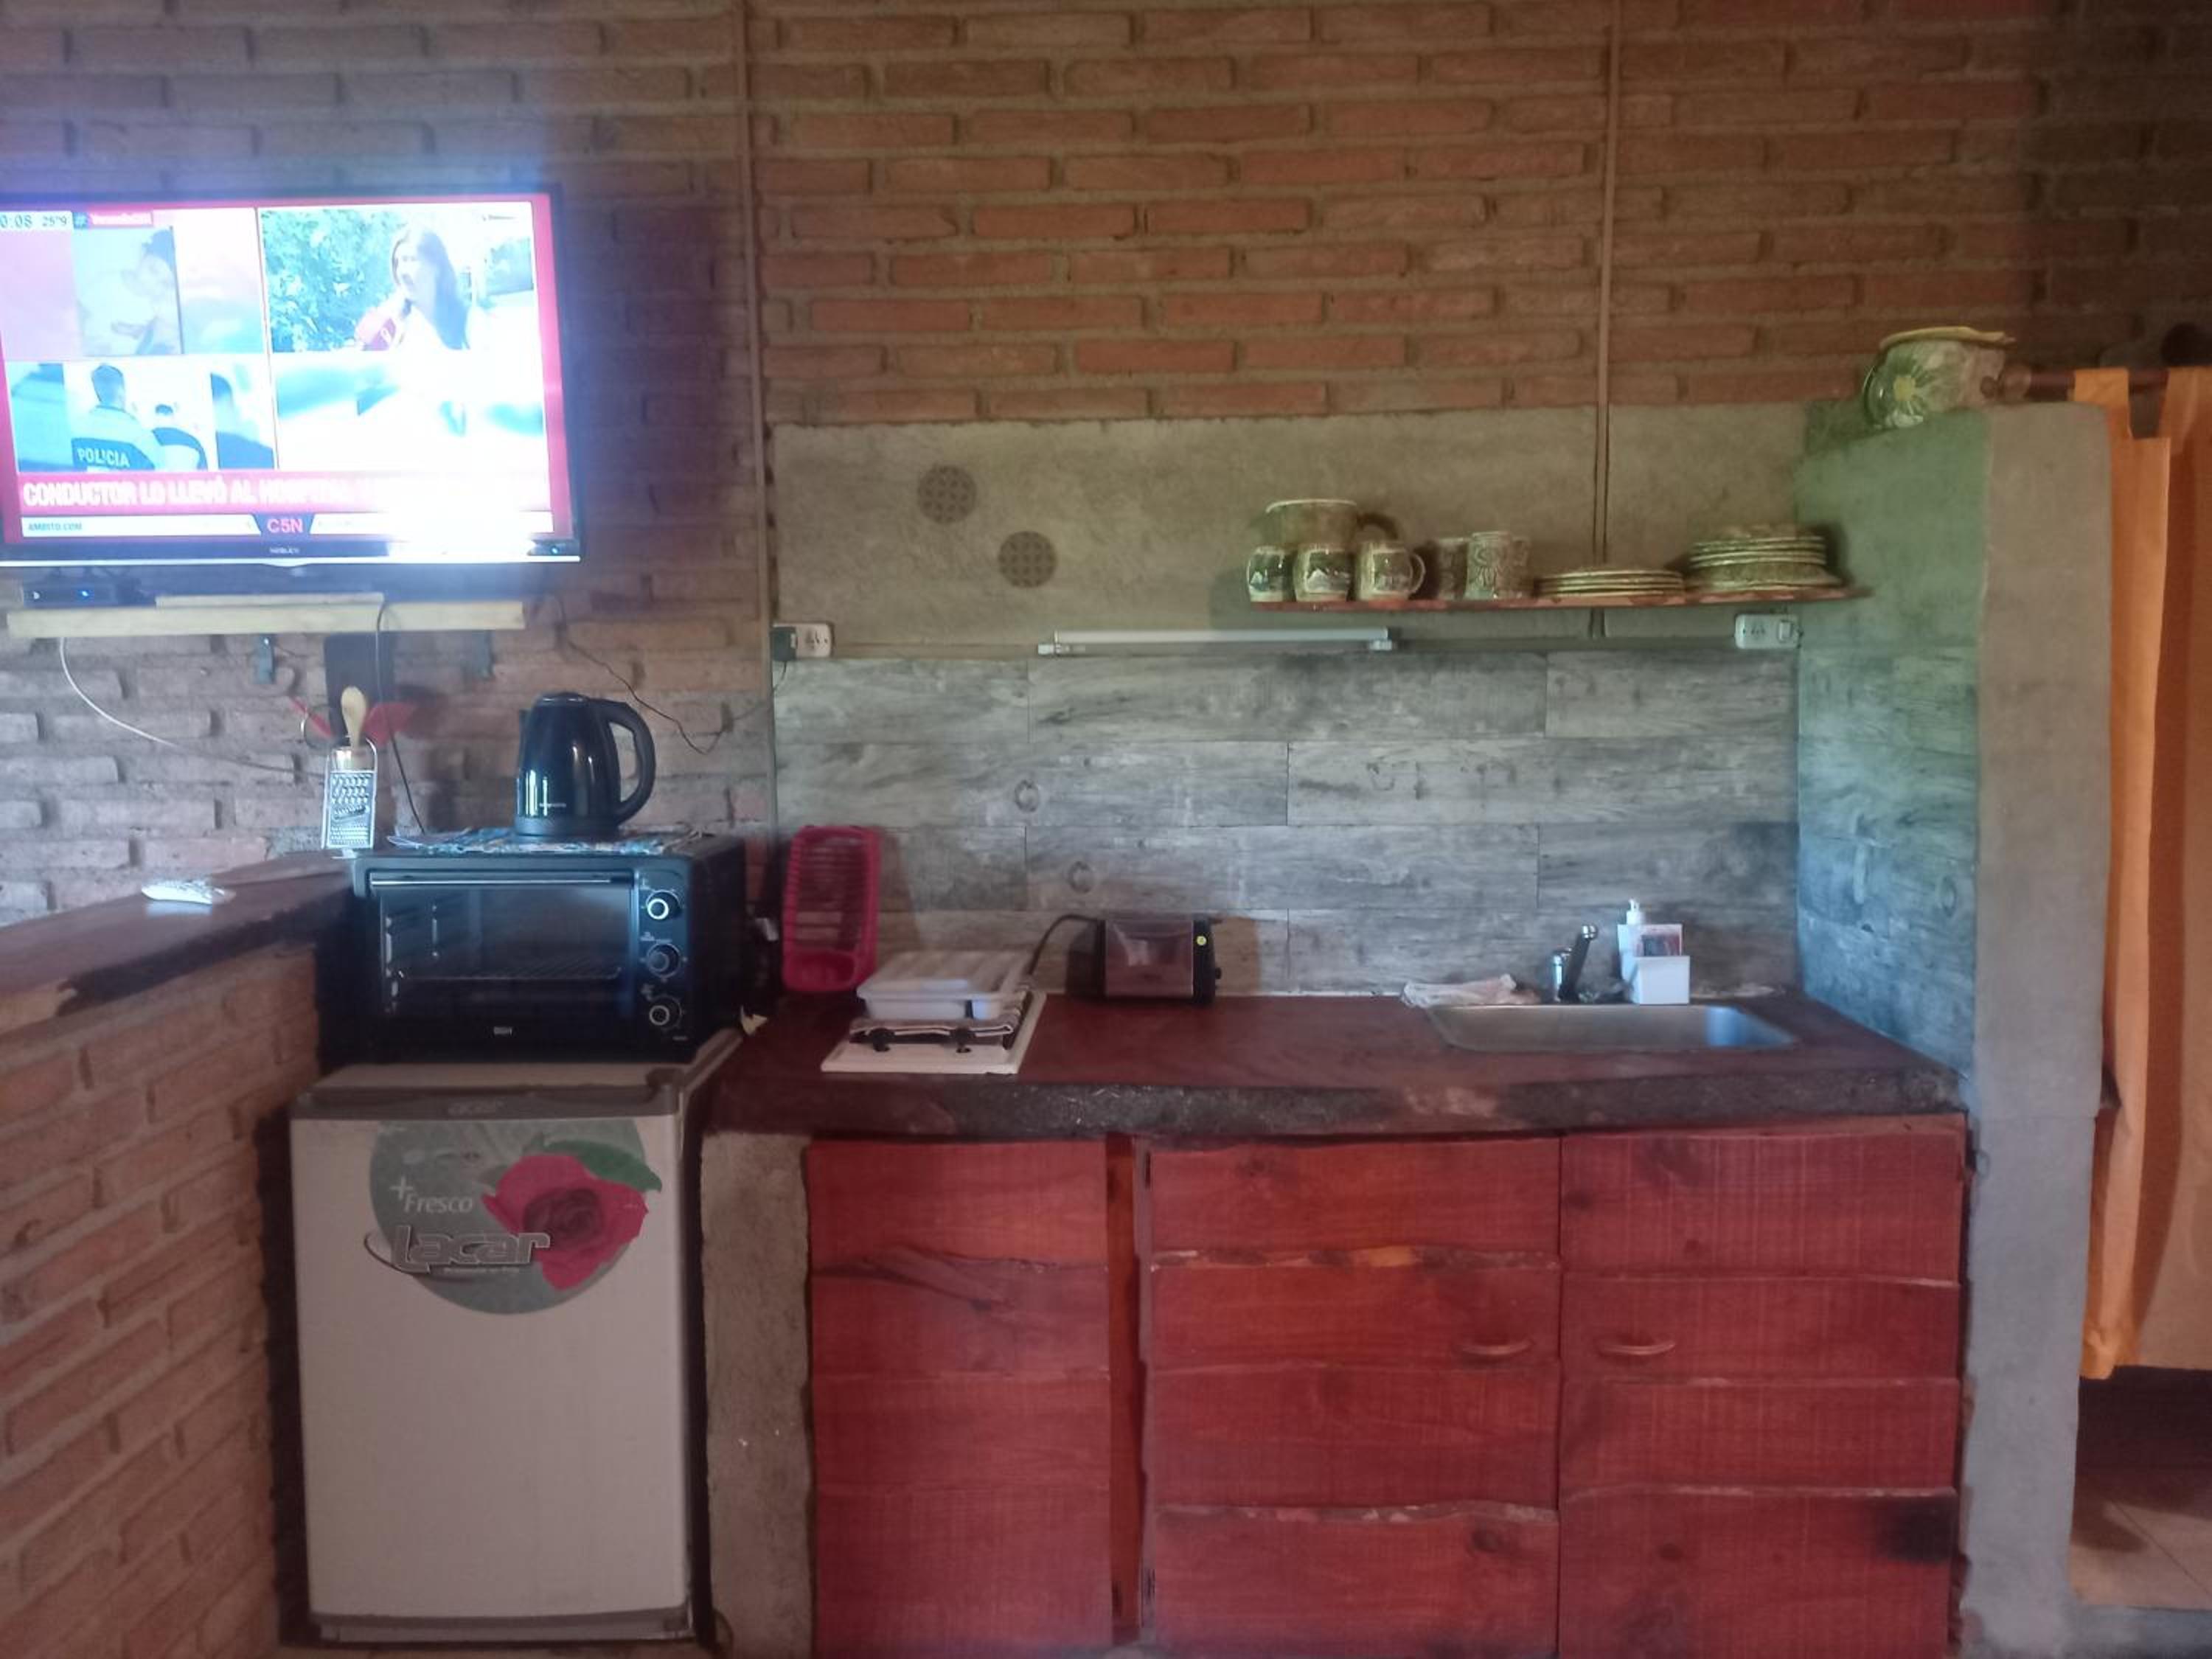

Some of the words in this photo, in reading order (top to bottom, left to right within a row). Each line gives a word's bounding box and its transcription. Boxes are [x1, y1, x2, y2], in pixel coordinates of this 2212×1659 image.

[76, 448, 131, 468] POLICIA
[23, 481, 137, 507] CONDUCTOR
[139, 480, 166, 506] LO
[230, 479, 258, 504] AL
[266, 518, 304, 533] C5N
